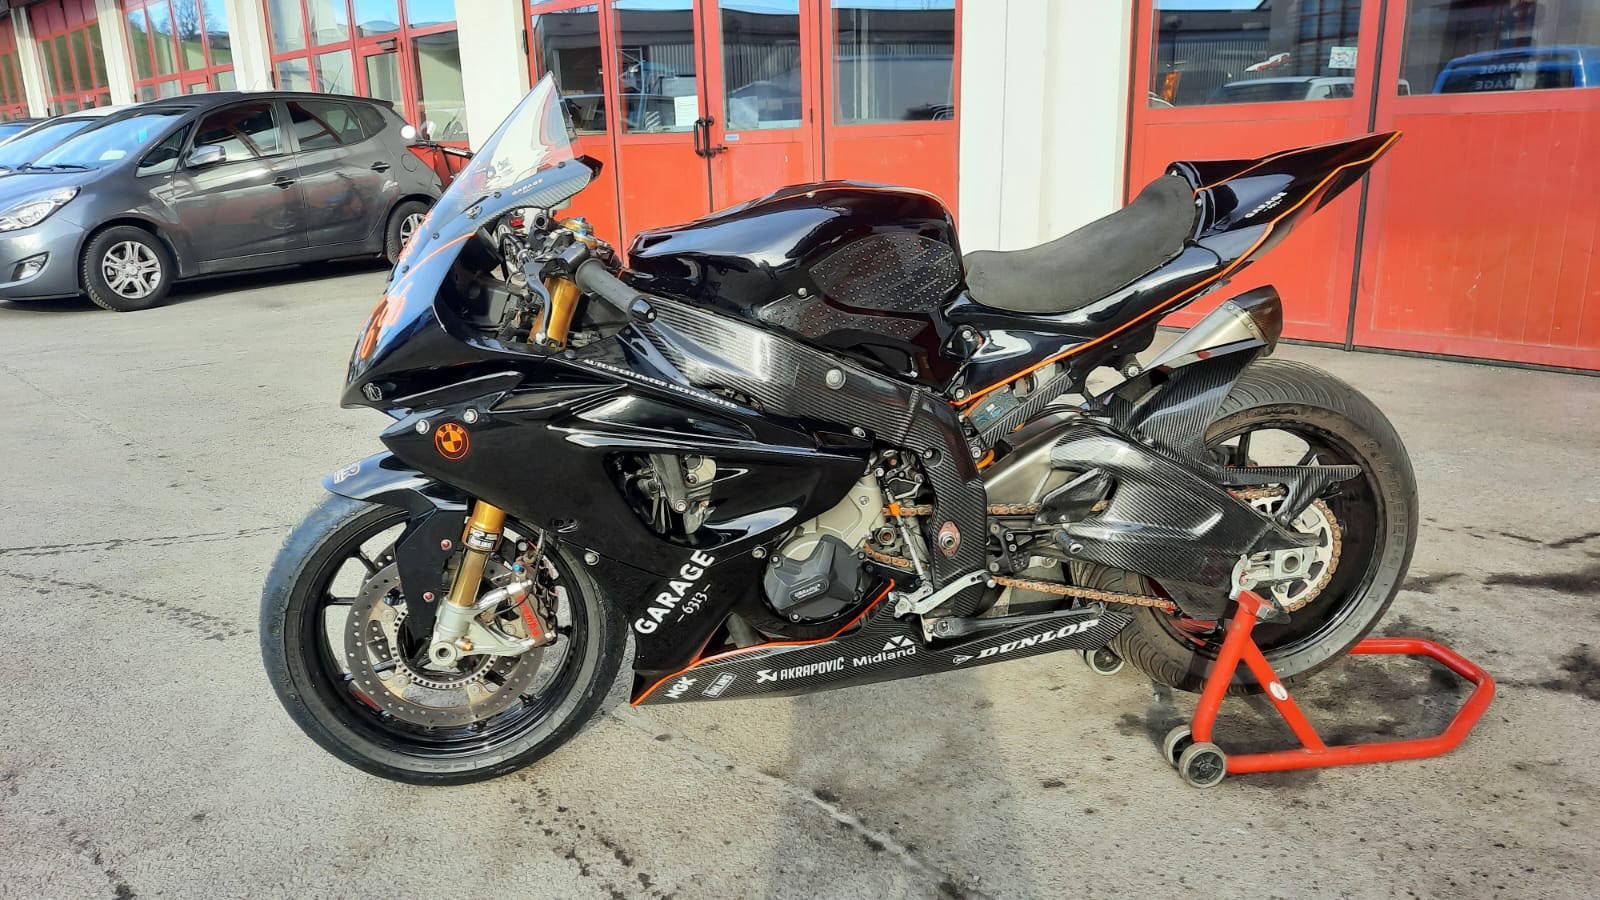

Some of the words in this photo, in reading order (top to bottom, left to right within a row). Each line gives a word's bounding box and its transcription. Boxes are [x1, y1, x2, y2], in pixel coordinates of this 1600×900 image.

[634, 549, 715, 635] GARAGE
[975, 618, 1099, 659] DUNLOP
[780, 656, 845, 681] AKRAPOVIC
[852, 645, 917, 667] Midland
[664, 676, 698, 699] NGK
